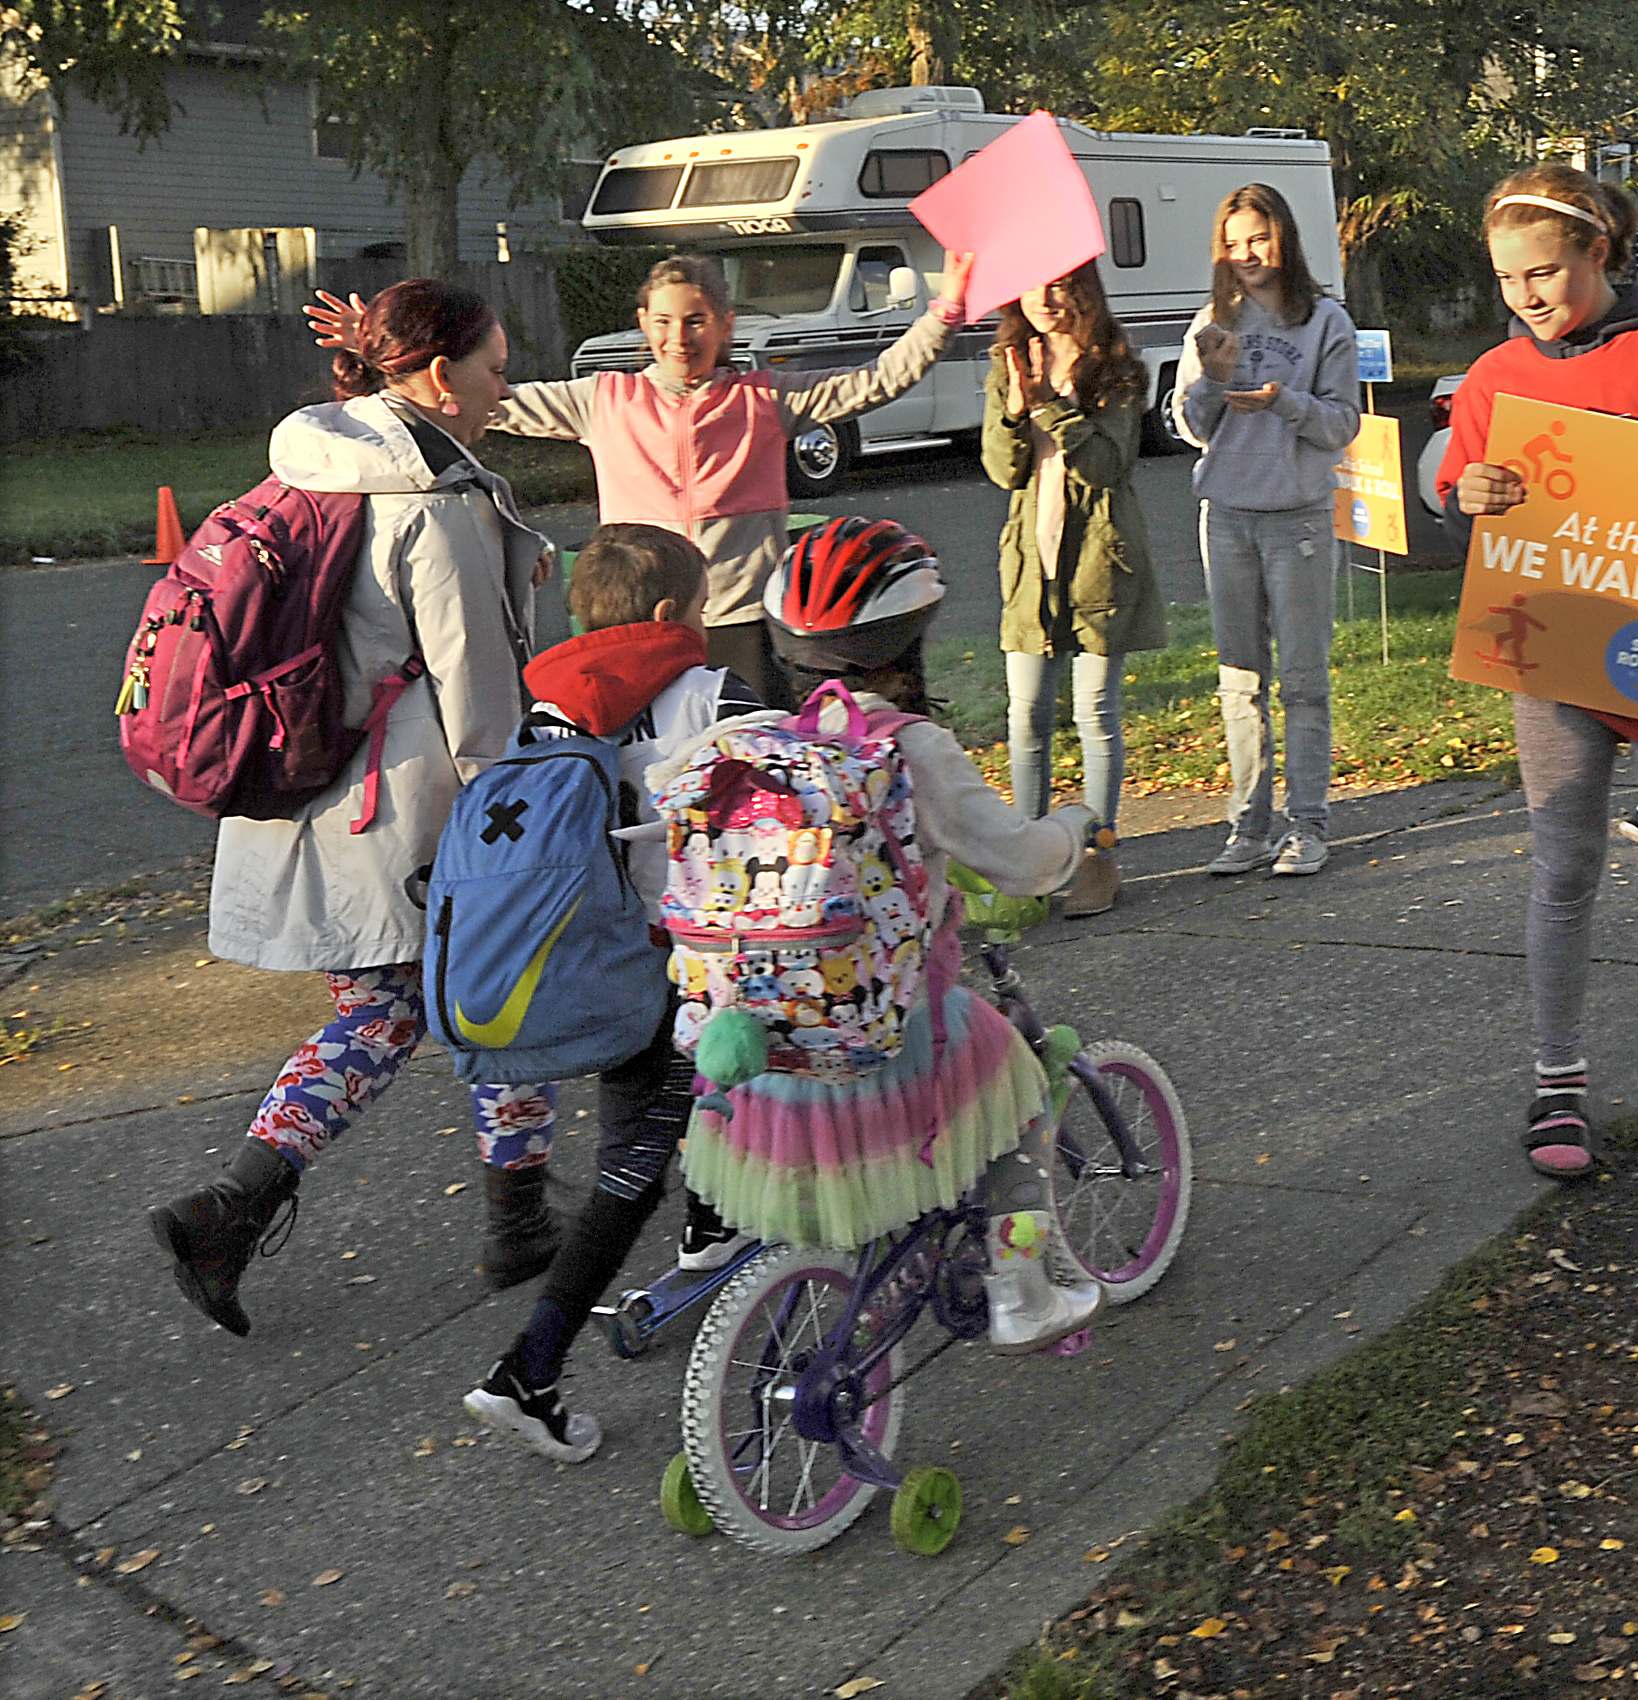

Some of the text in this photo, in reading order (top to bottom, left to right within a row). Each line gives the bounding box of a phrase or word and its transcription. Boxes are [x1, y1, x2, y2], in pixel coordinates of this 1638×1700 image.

[727, 218, 792, 235] TIOGA
[1552, 511, 1599, 545] At
[1482, 532, 1548, 579] WE
